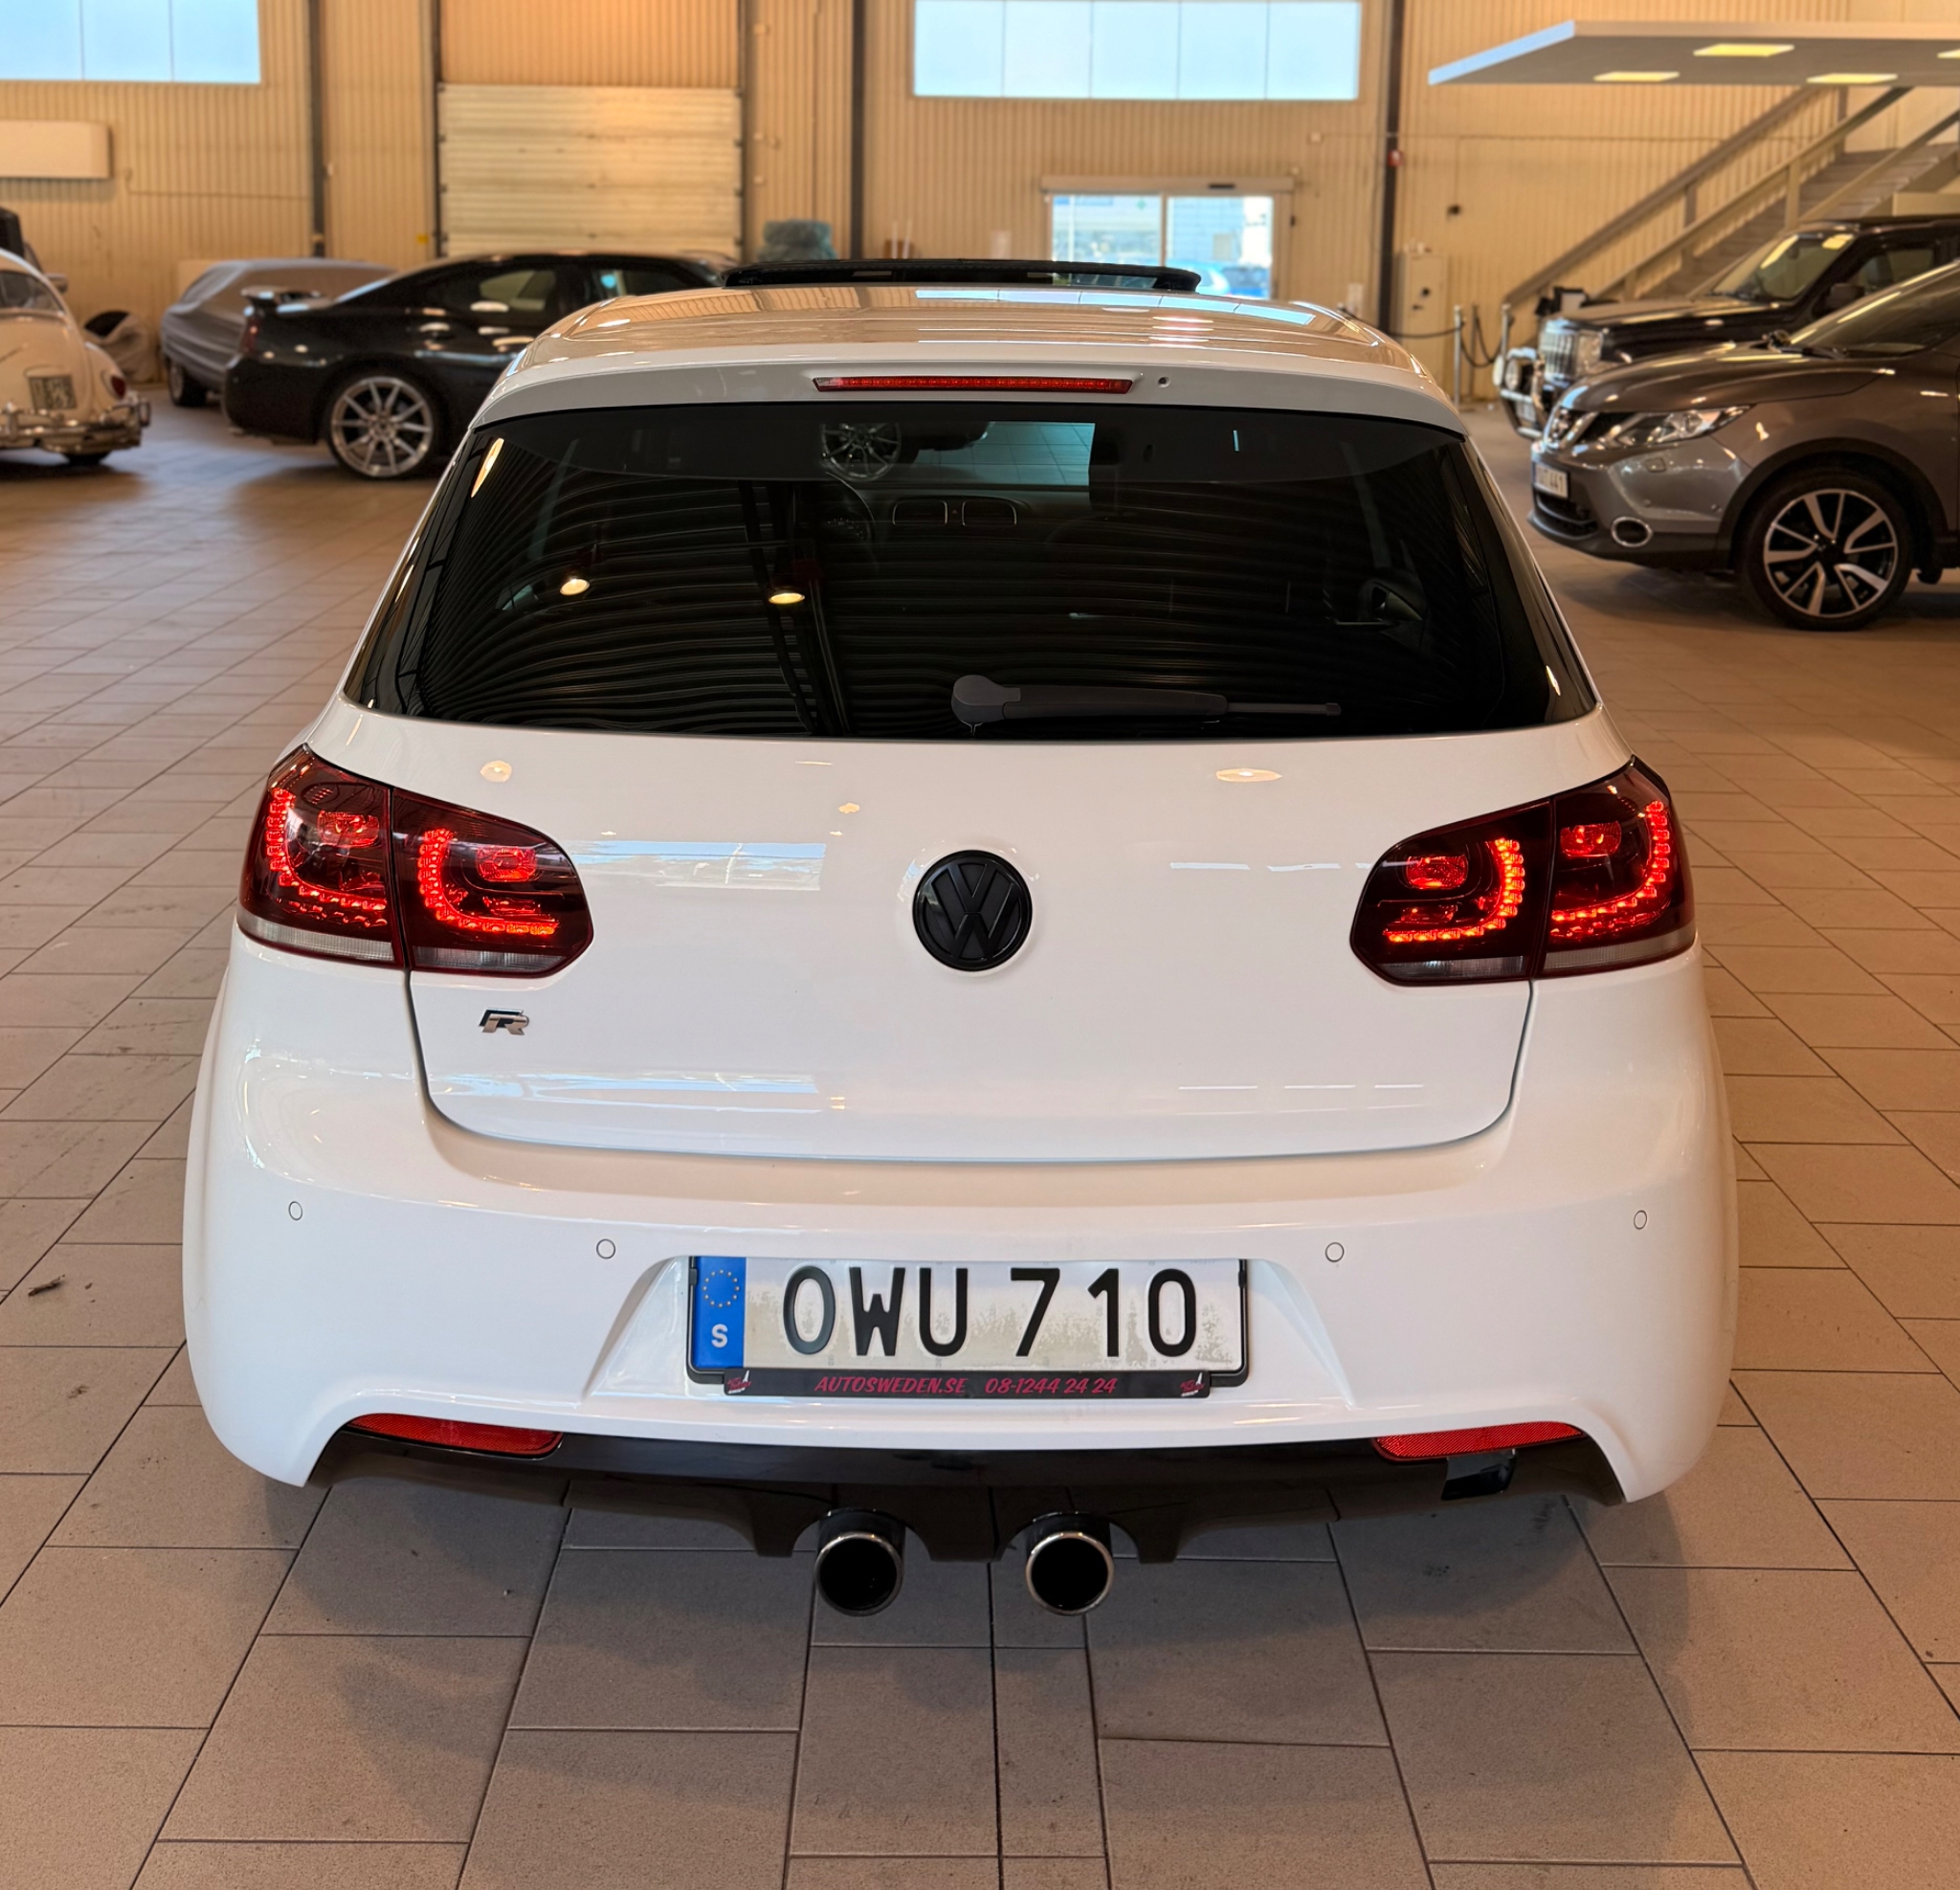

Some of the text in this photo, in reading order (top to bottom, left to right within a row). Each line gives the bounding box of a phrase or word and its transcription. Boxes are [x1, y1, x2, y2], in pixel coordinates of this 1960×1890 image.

[916, 854, 1029, 967] VW
[479, 1008, 529, 1035] R
[783, 1265, 1197, 1358] OWU 710
[711, 1323, 728, 1348] S
[814, 1376, 1118, 1394] AUTOSWEDEN.SE 08-1244 24 24
